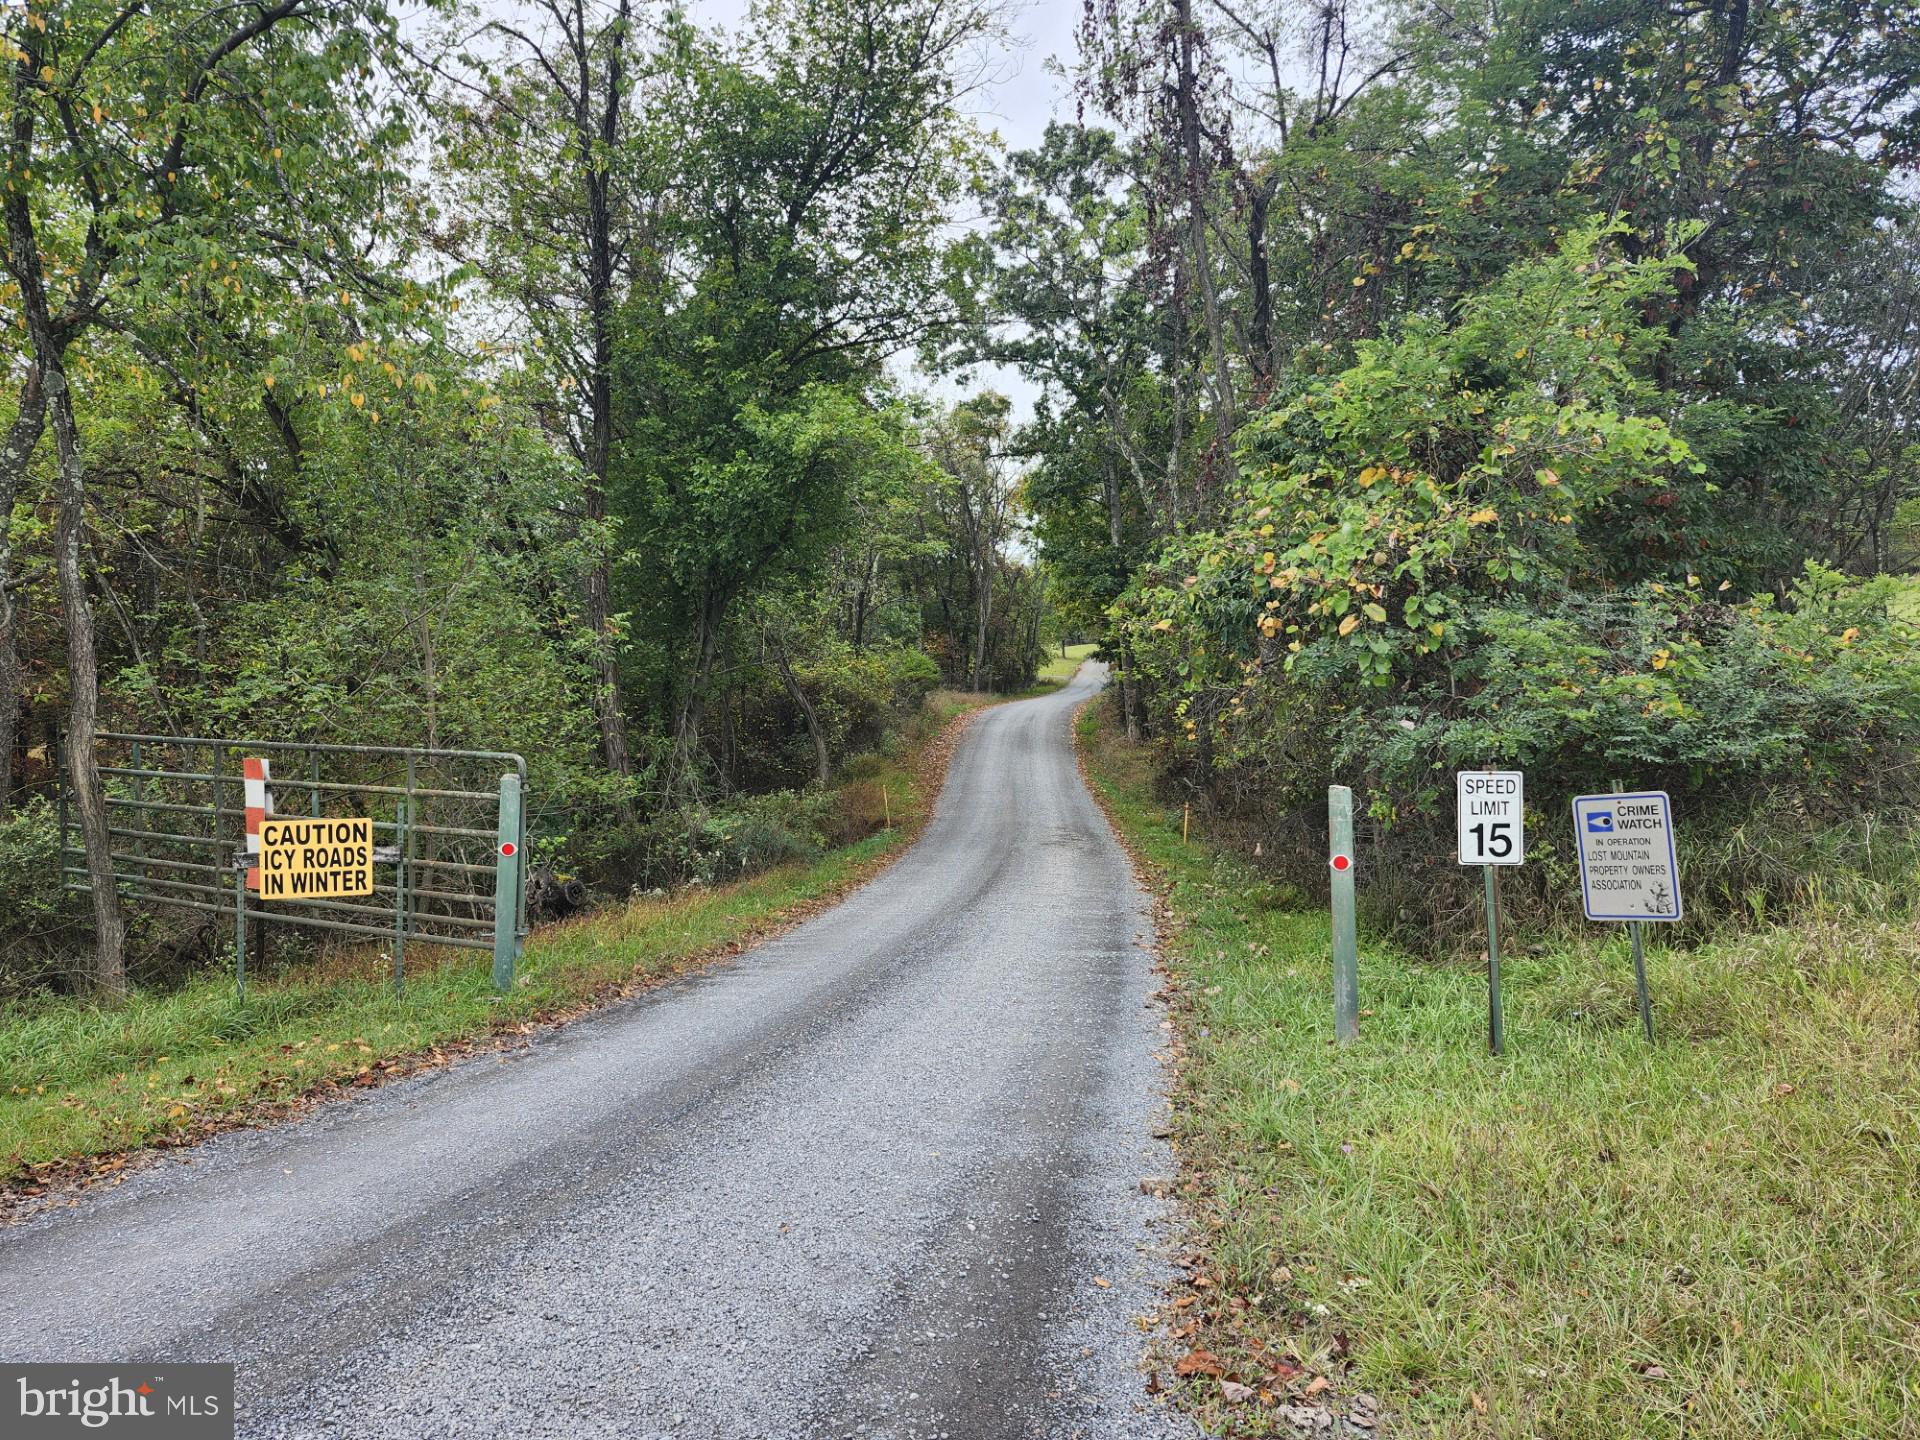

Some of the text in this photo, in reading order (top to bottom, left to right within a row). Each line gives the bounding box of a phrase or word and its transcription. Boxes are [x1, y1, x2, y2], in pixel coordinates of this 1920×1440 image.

[1465, 779, 1516, 794] SPEED
[1471, 801, 1509, 815] LIMIT
[1617, 805, 1659, 816] CRIME
[1617, 819, 1662, 829] WATCH
[264, 823, 367, 846] CAUTION
[1469, 823, 1512, 857] 15
[1607, 838, 1651, 846] OPERATION
[264, 846, 367, 870] ICY ROADS
[1588, 850, 1650, 861] LOST MOUNTAIN
[1590, 865, 1666, 875] PROPERTY OWNERS
[264, 870, 367, 894] IN WINTER
[1592, 880, 1642, 890] ASSOCIATION
